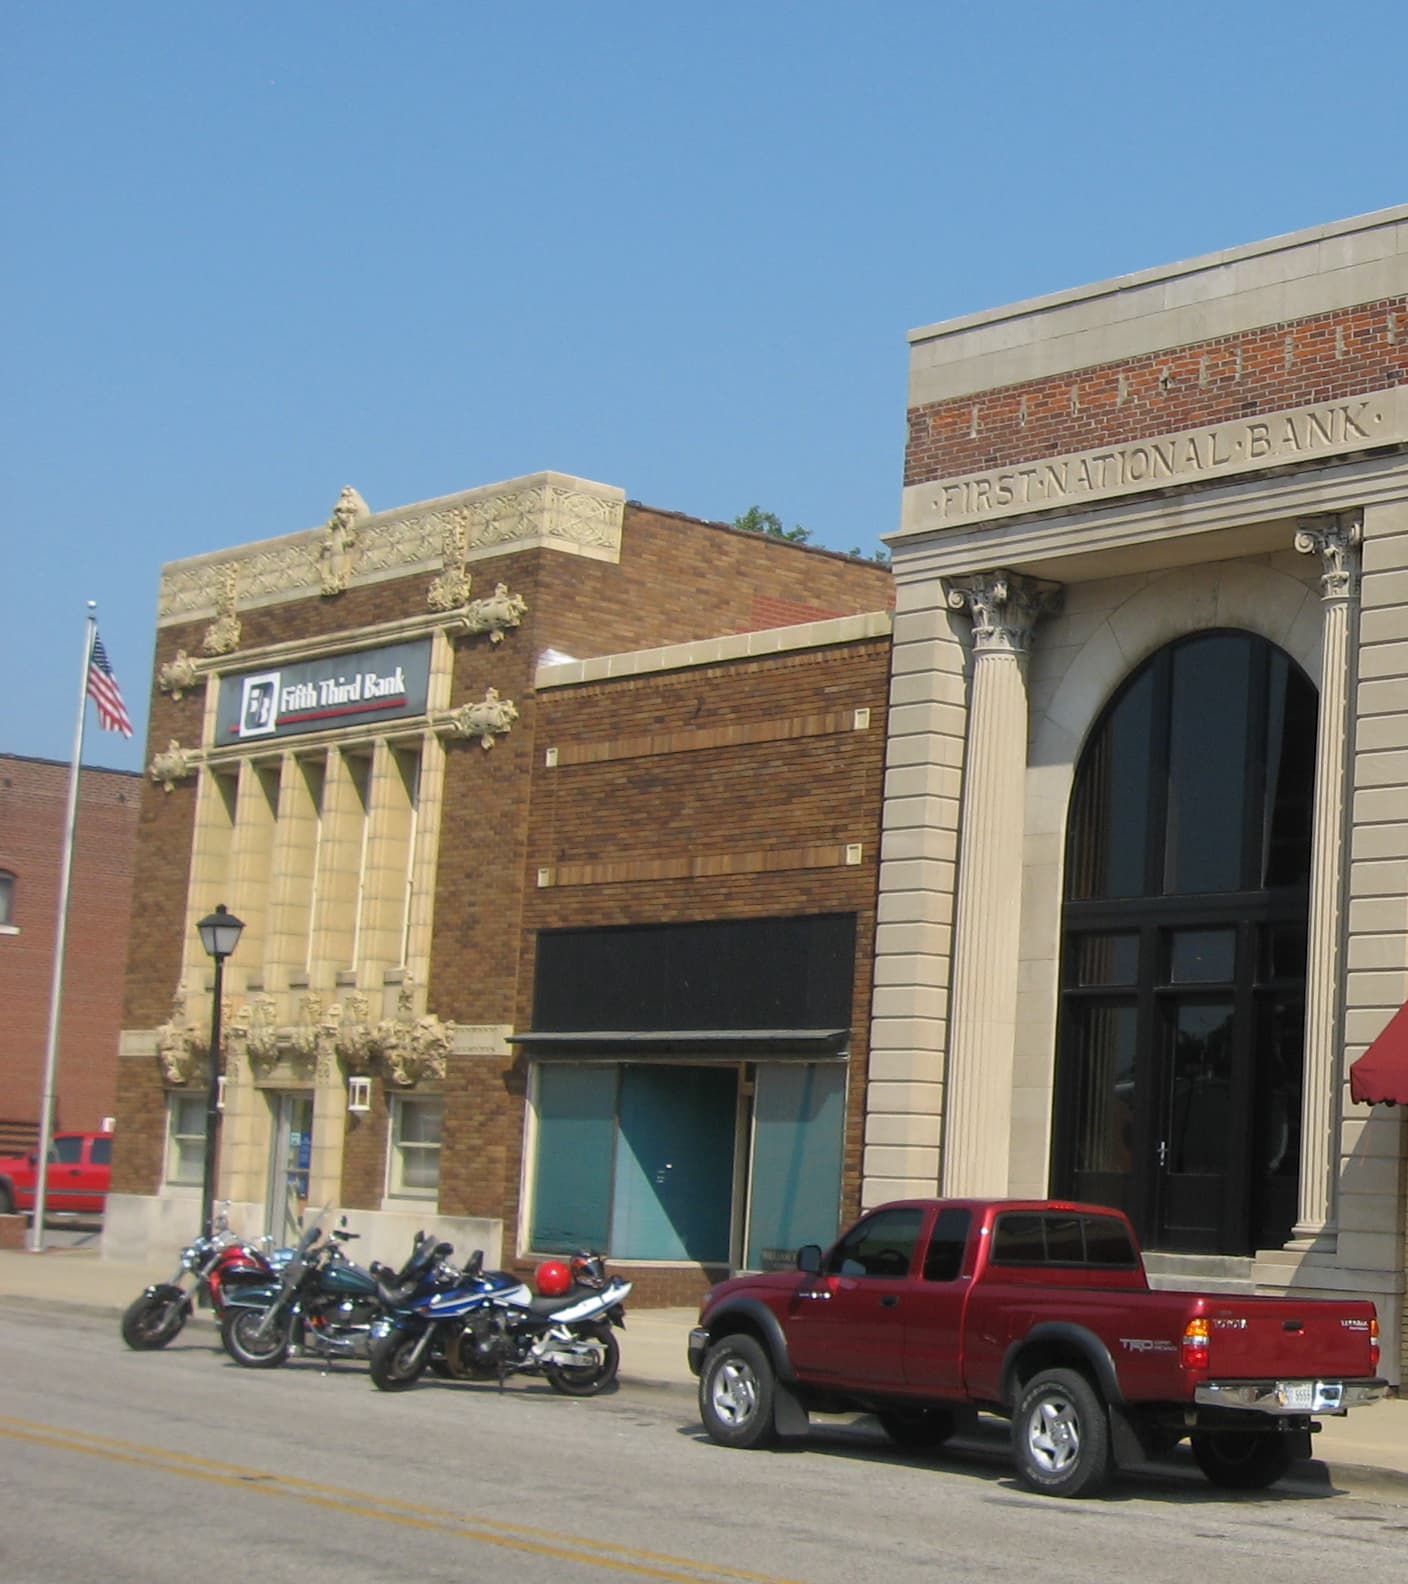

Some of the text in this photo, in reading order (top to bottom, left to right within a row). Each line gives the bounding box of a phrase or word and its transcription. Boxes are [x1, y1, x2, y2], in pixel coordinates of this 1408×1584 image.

[940, 402, 1370, 518] FIRST NATIONAL BANK
[280, 666, 406, 713] Fifth Third Bank
